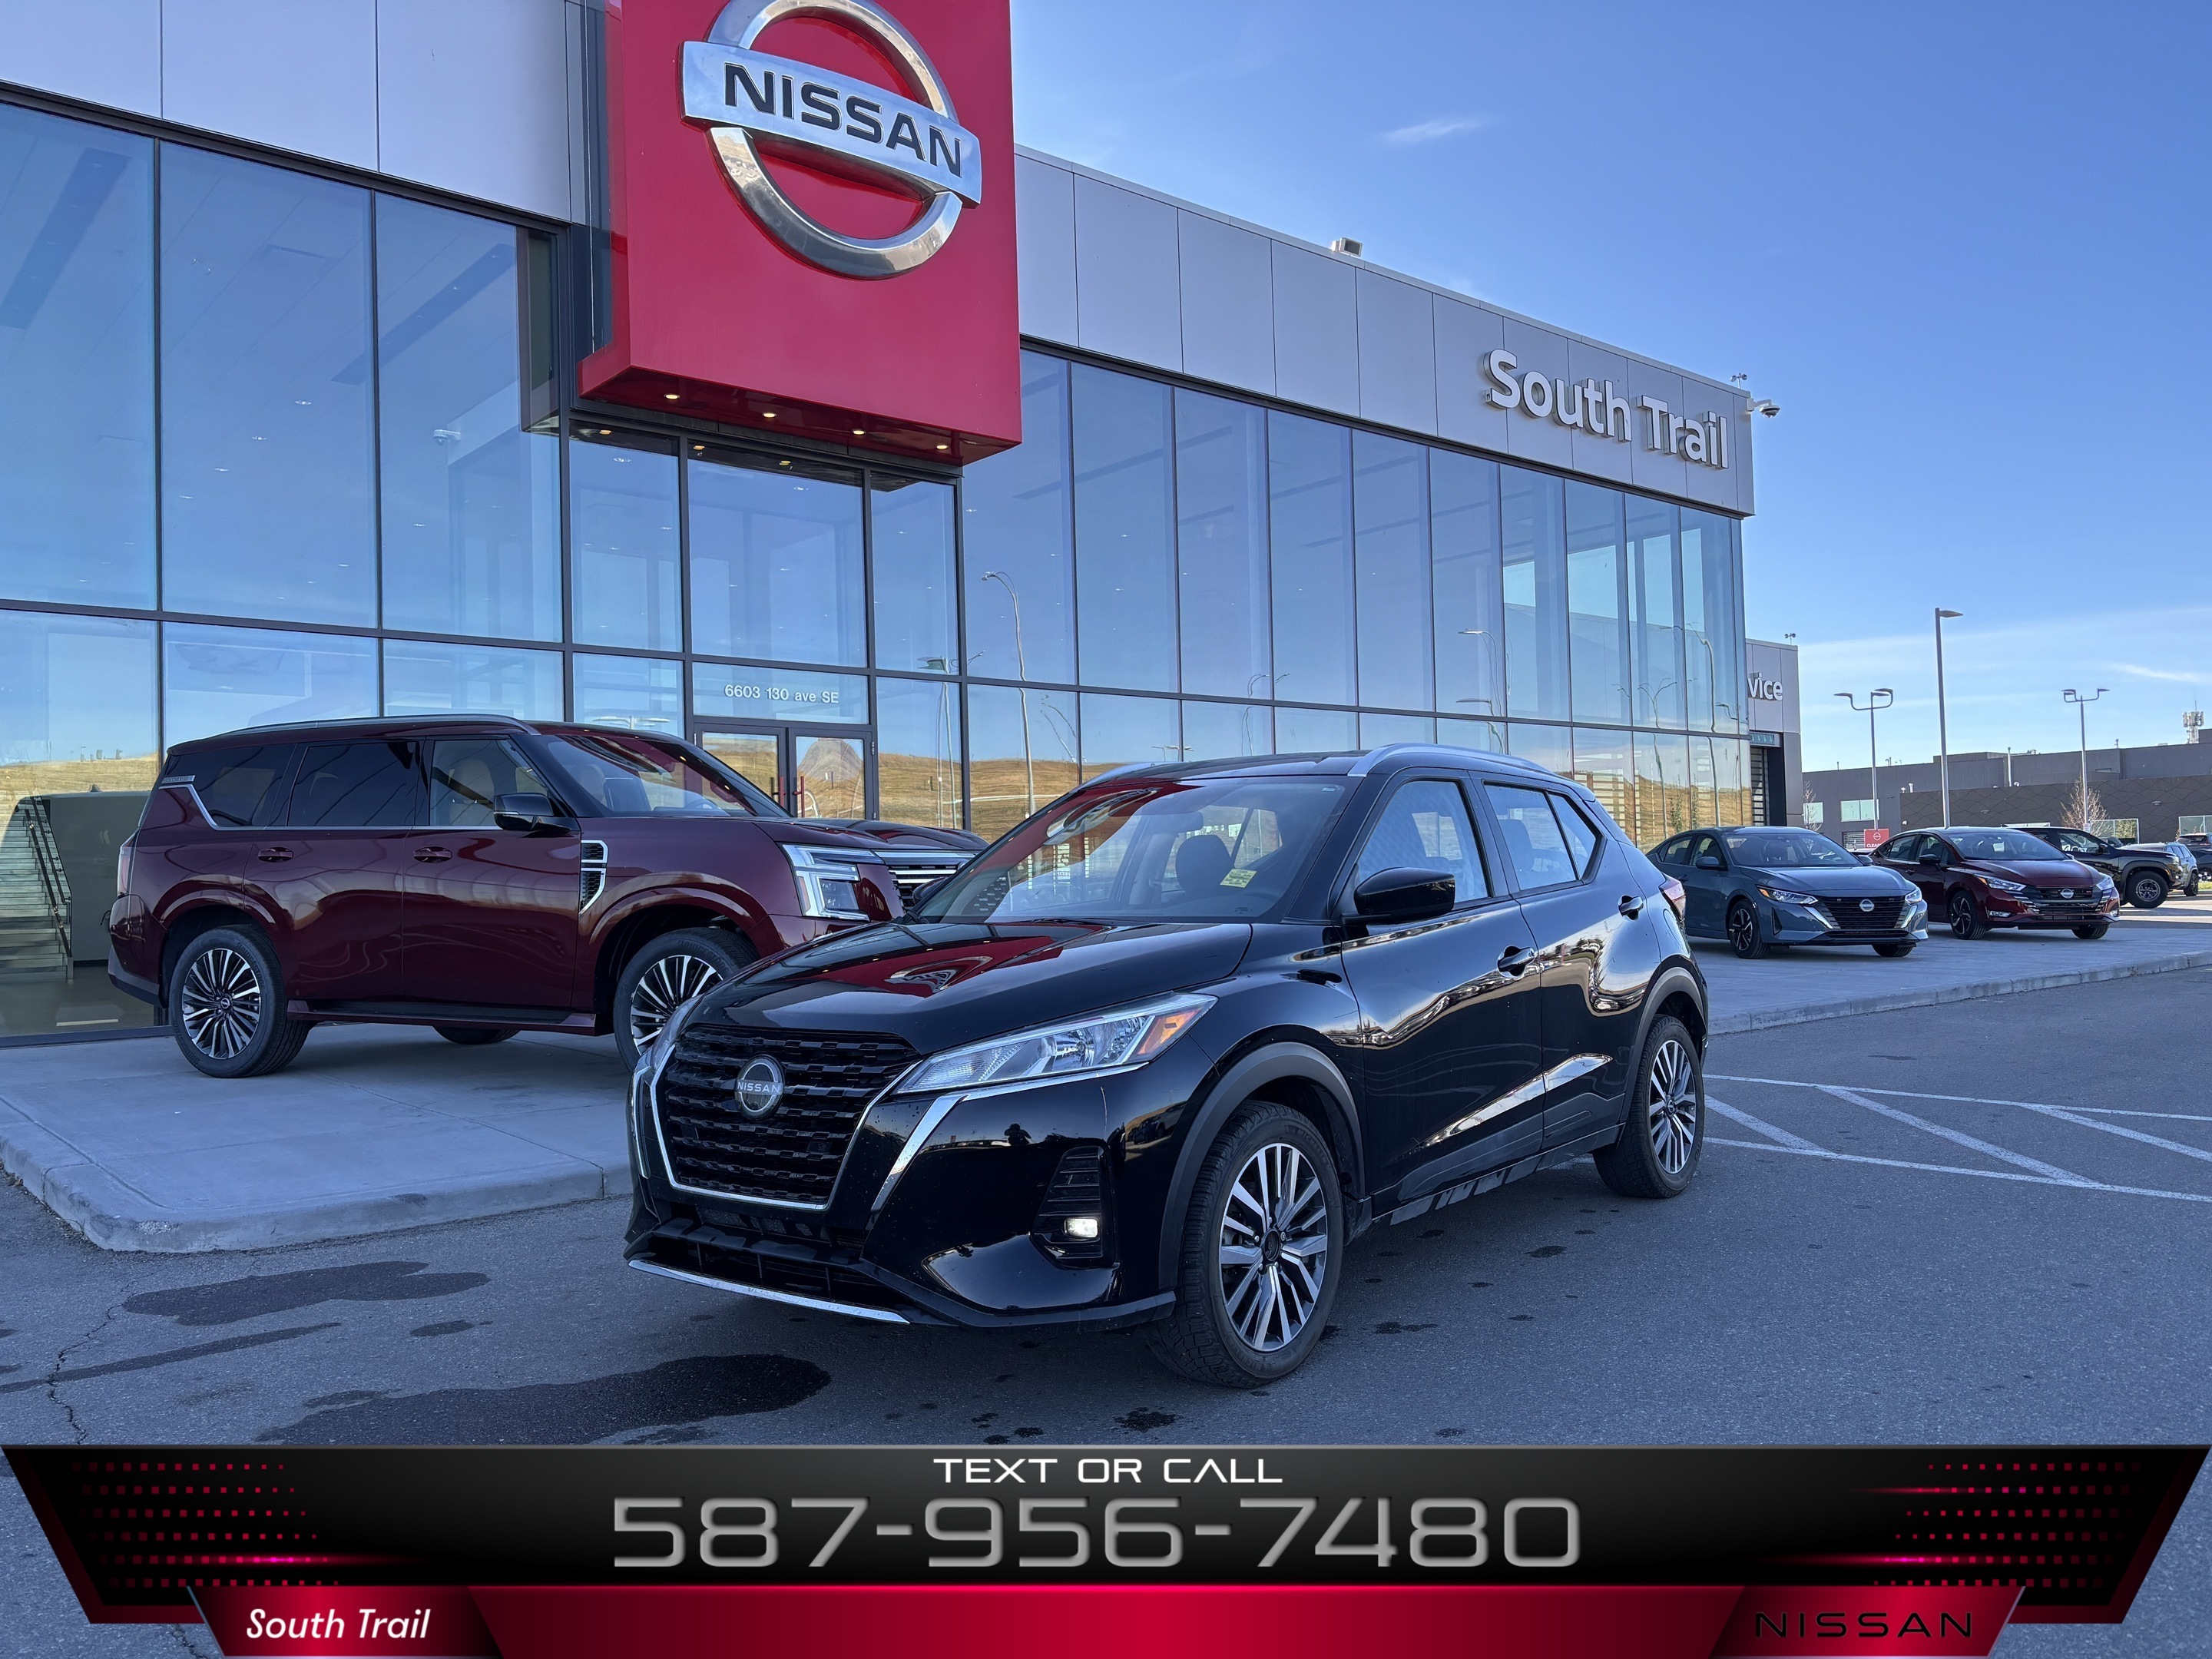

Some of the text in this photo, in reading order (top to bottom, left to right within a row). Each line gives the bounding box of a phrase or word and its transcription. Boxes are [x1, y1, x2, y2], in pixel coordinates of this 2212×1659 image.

[724, 61, 962, 178] NISSAN
[1484, 349, 1728, 469] South Trail
[725, 684, 839, 704] 6603 130 ave SE
[737, 1081, 780, 1093] NISSAN
